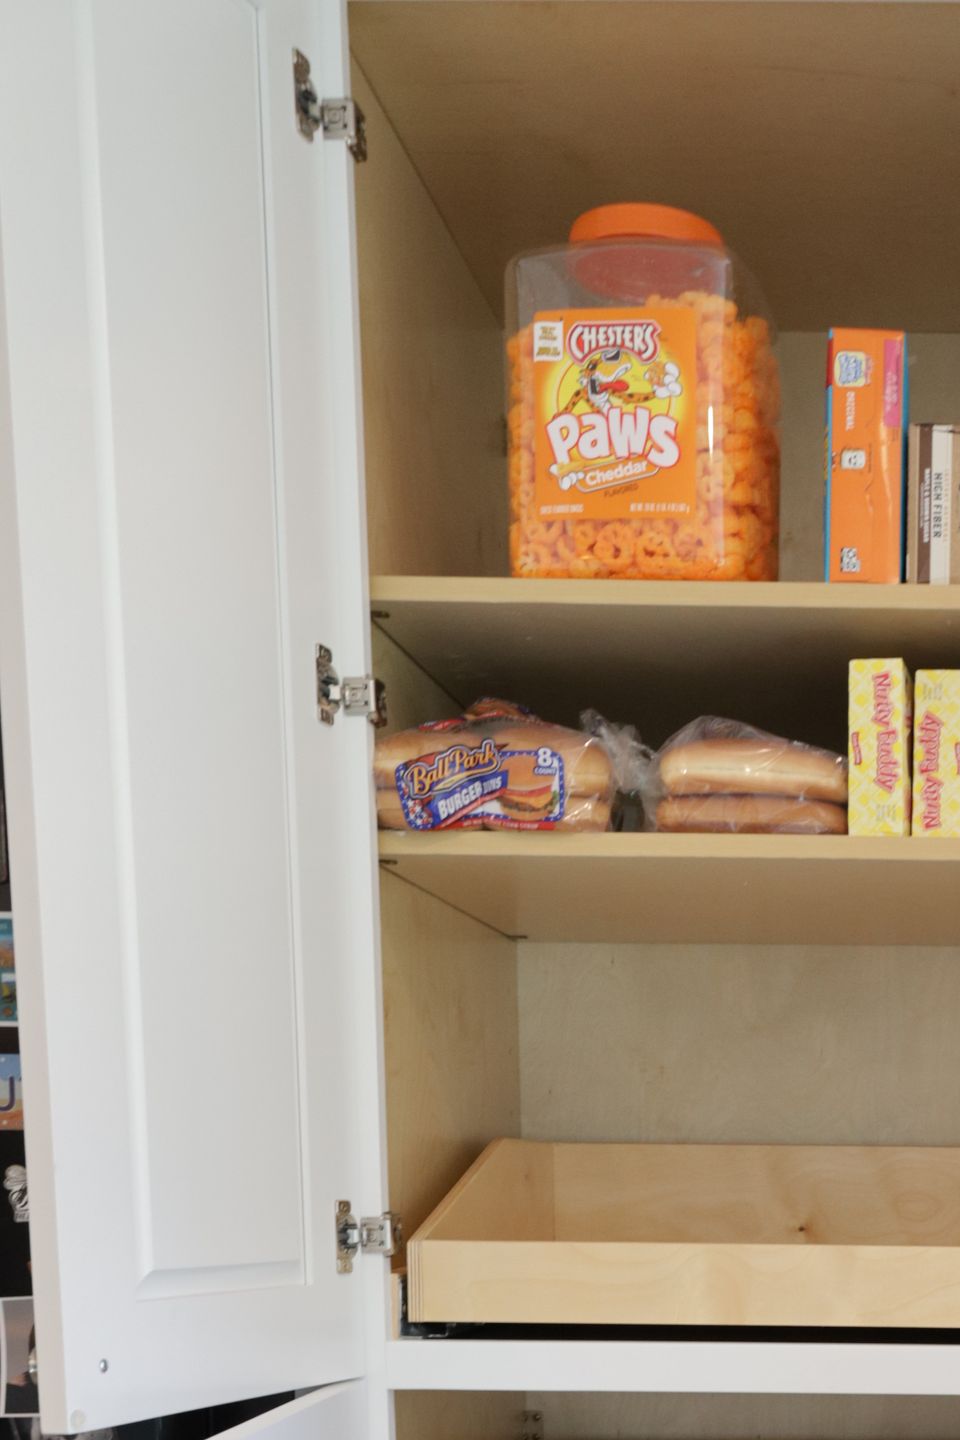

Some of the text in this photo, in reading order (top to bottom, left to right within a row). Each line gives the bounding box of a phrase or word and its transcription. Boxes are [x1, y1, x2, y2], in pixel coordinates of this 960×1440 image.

[569, 324, 656, 359] CHESTER'S
[585, 461, 649, 486] Cheddar
[933, 473, 943, 539] HIGH FIBER
[871, 672, 894, 726] Nutty
[406, 742, 496, 796] Ball Park
[537, 748, 552, 766] 8
[872, 728, 898, 792] Buddy
[918, 713, 944, 775] Buddy
[437, 781, 483, 818] BURGER
[923, 777, 945, 830] Nutty
